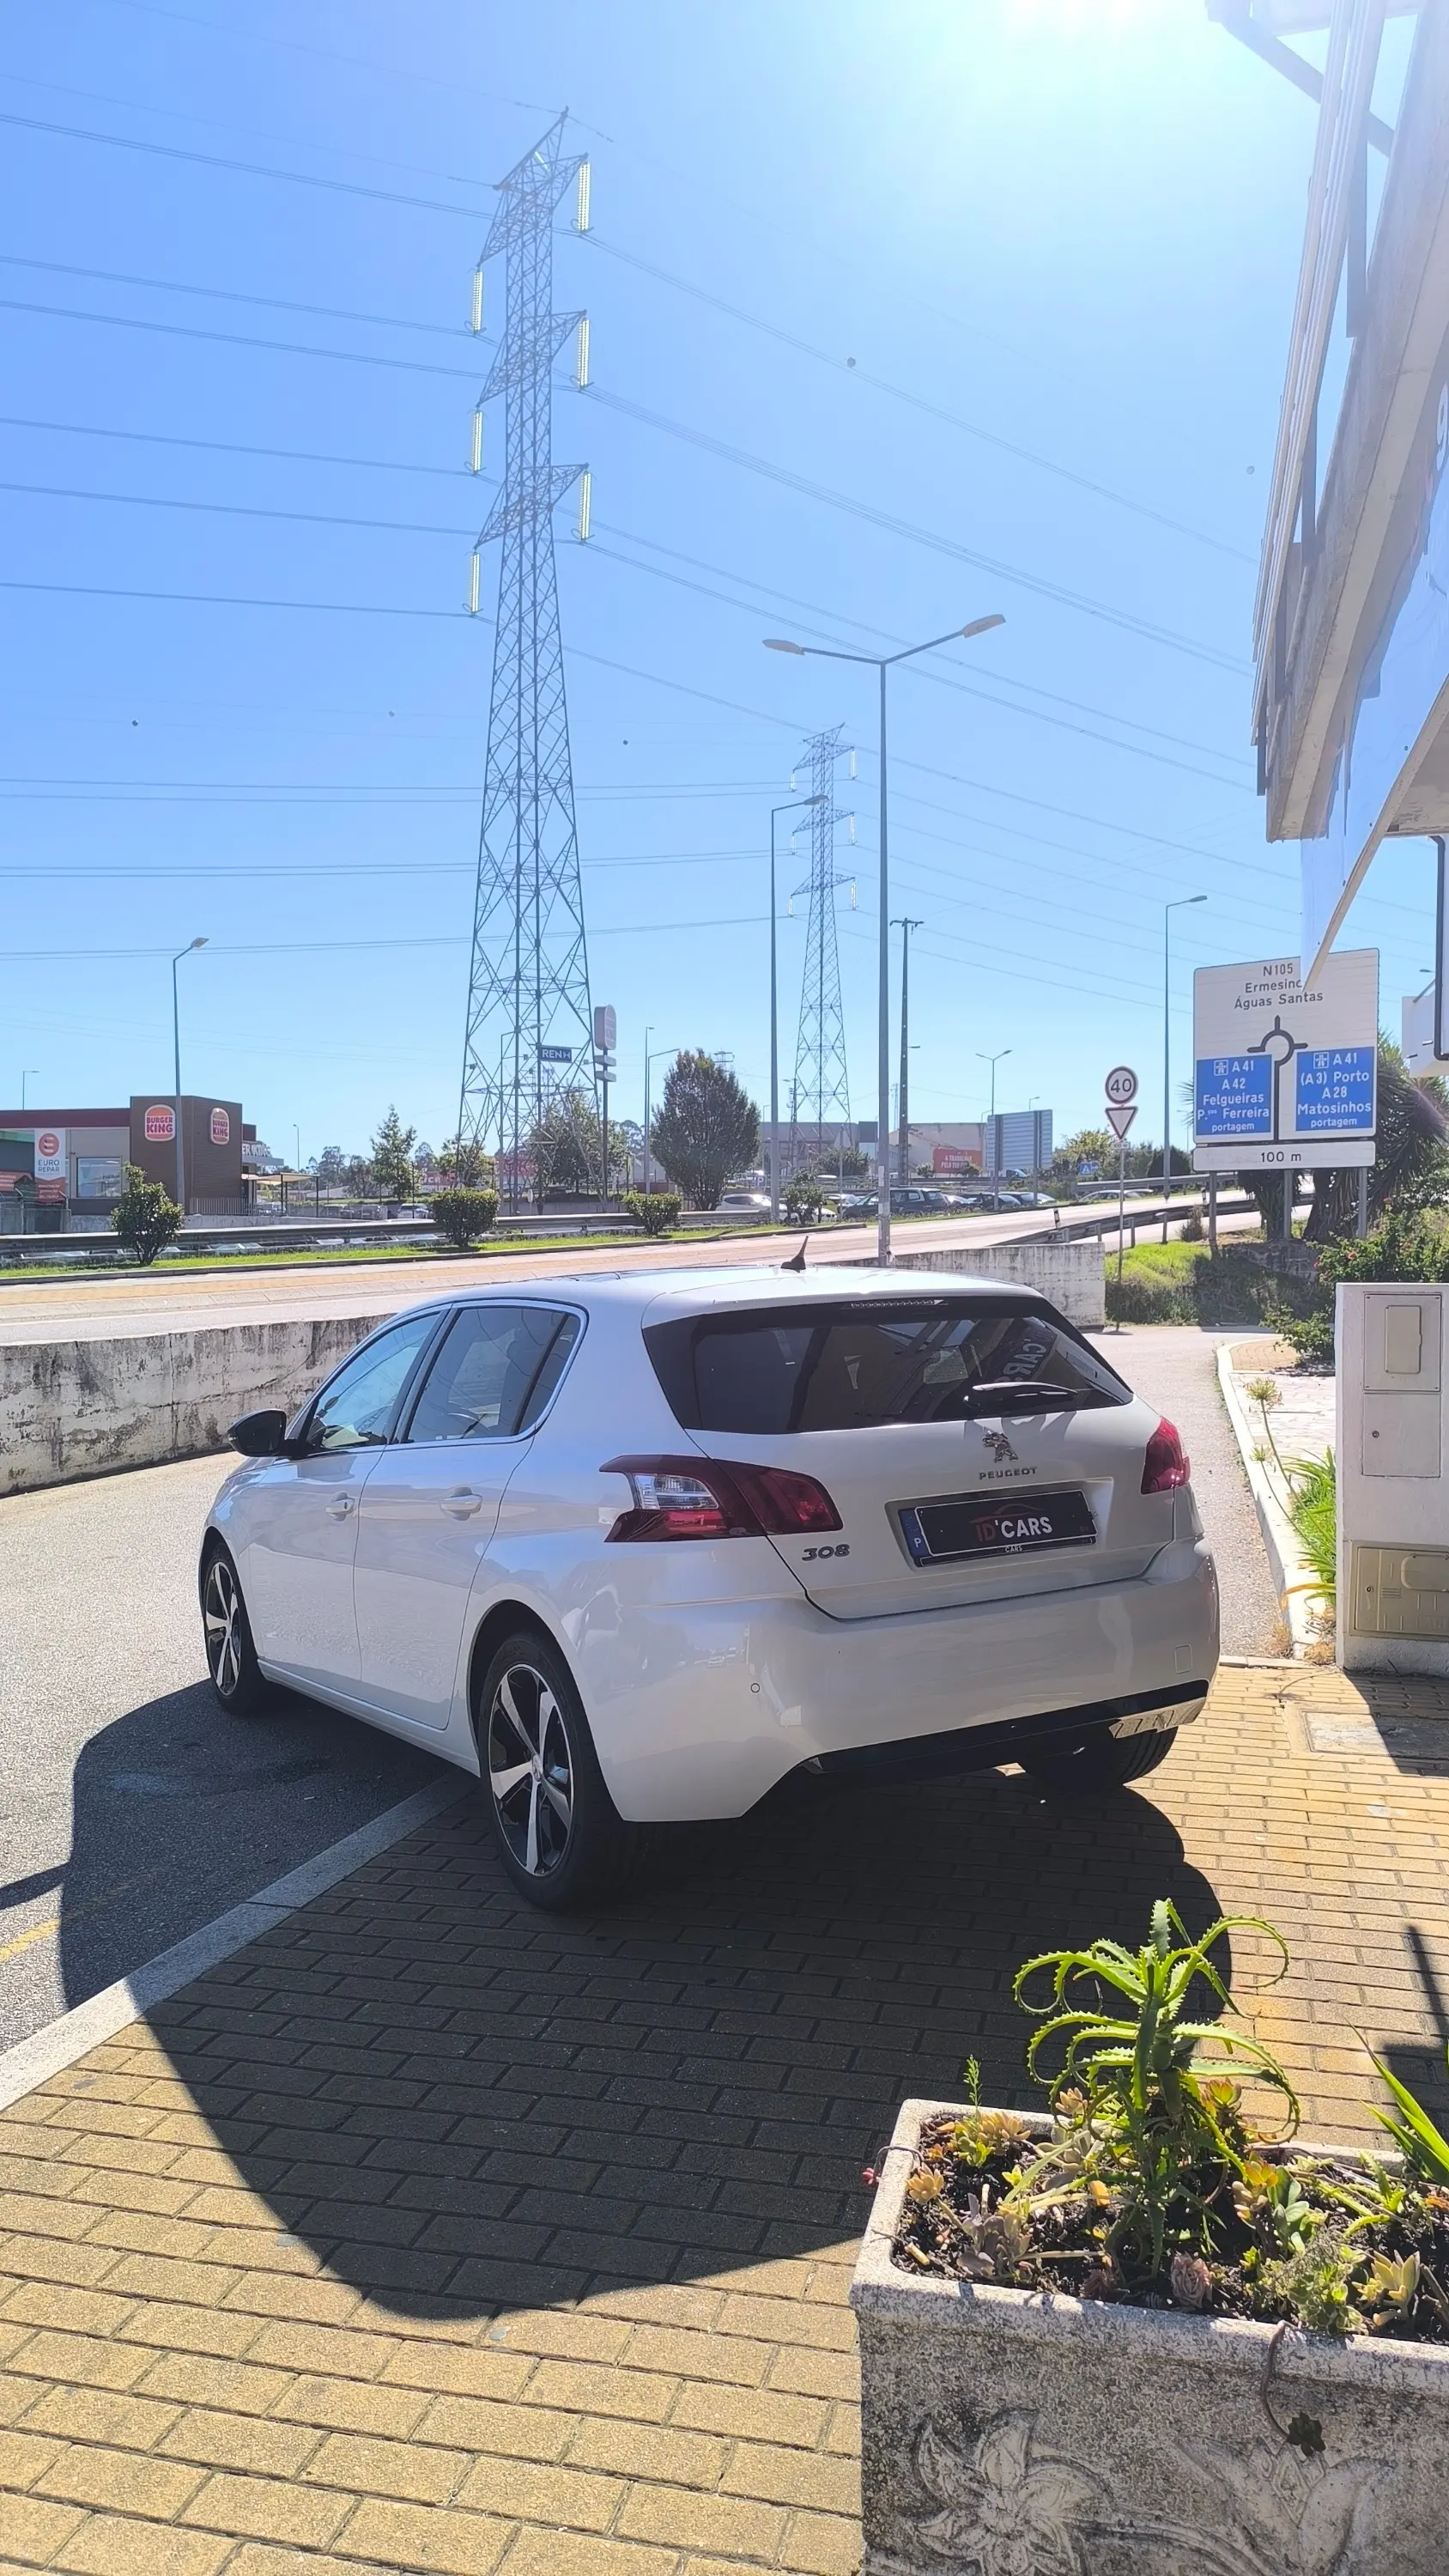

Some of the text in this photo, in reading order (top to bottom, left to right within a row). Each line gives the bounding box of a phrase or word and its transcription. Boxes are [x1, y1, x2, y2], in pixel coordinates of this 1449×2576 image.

[1245, 978, 1303, 993] Ermesin
[1234, 991, 1324, 1011] Águas Santas
[542, 1048, 562, 1059] REN
[1333, 1070, 1370, 1084] Porto
[1110, 1078, 1132, 1093] 40
[1203, 1092, 1264, 1107] Felgueiras
[1222, 1106, 1270, 1120] Ferreira
[1297, 1101, 1372, 1115] Matosinhos
[146, 1123, 173, 1133] KING
[212, 1119, 228, 1127] BURGER
[1211, 1122, 1255, 1133] portagem
[1310, 1118, 1357, 1129] portagem
[212, 1126, 228, 1138] KING
[1260, 1151, 1301, 1163] 100 m
[757, 1176, 764, 1186] P
[979, 1467, 1038, 1480] PEUGEOT
[913, 1537, 922, 1548] P
[801, 1543, 851, 1562] 308
